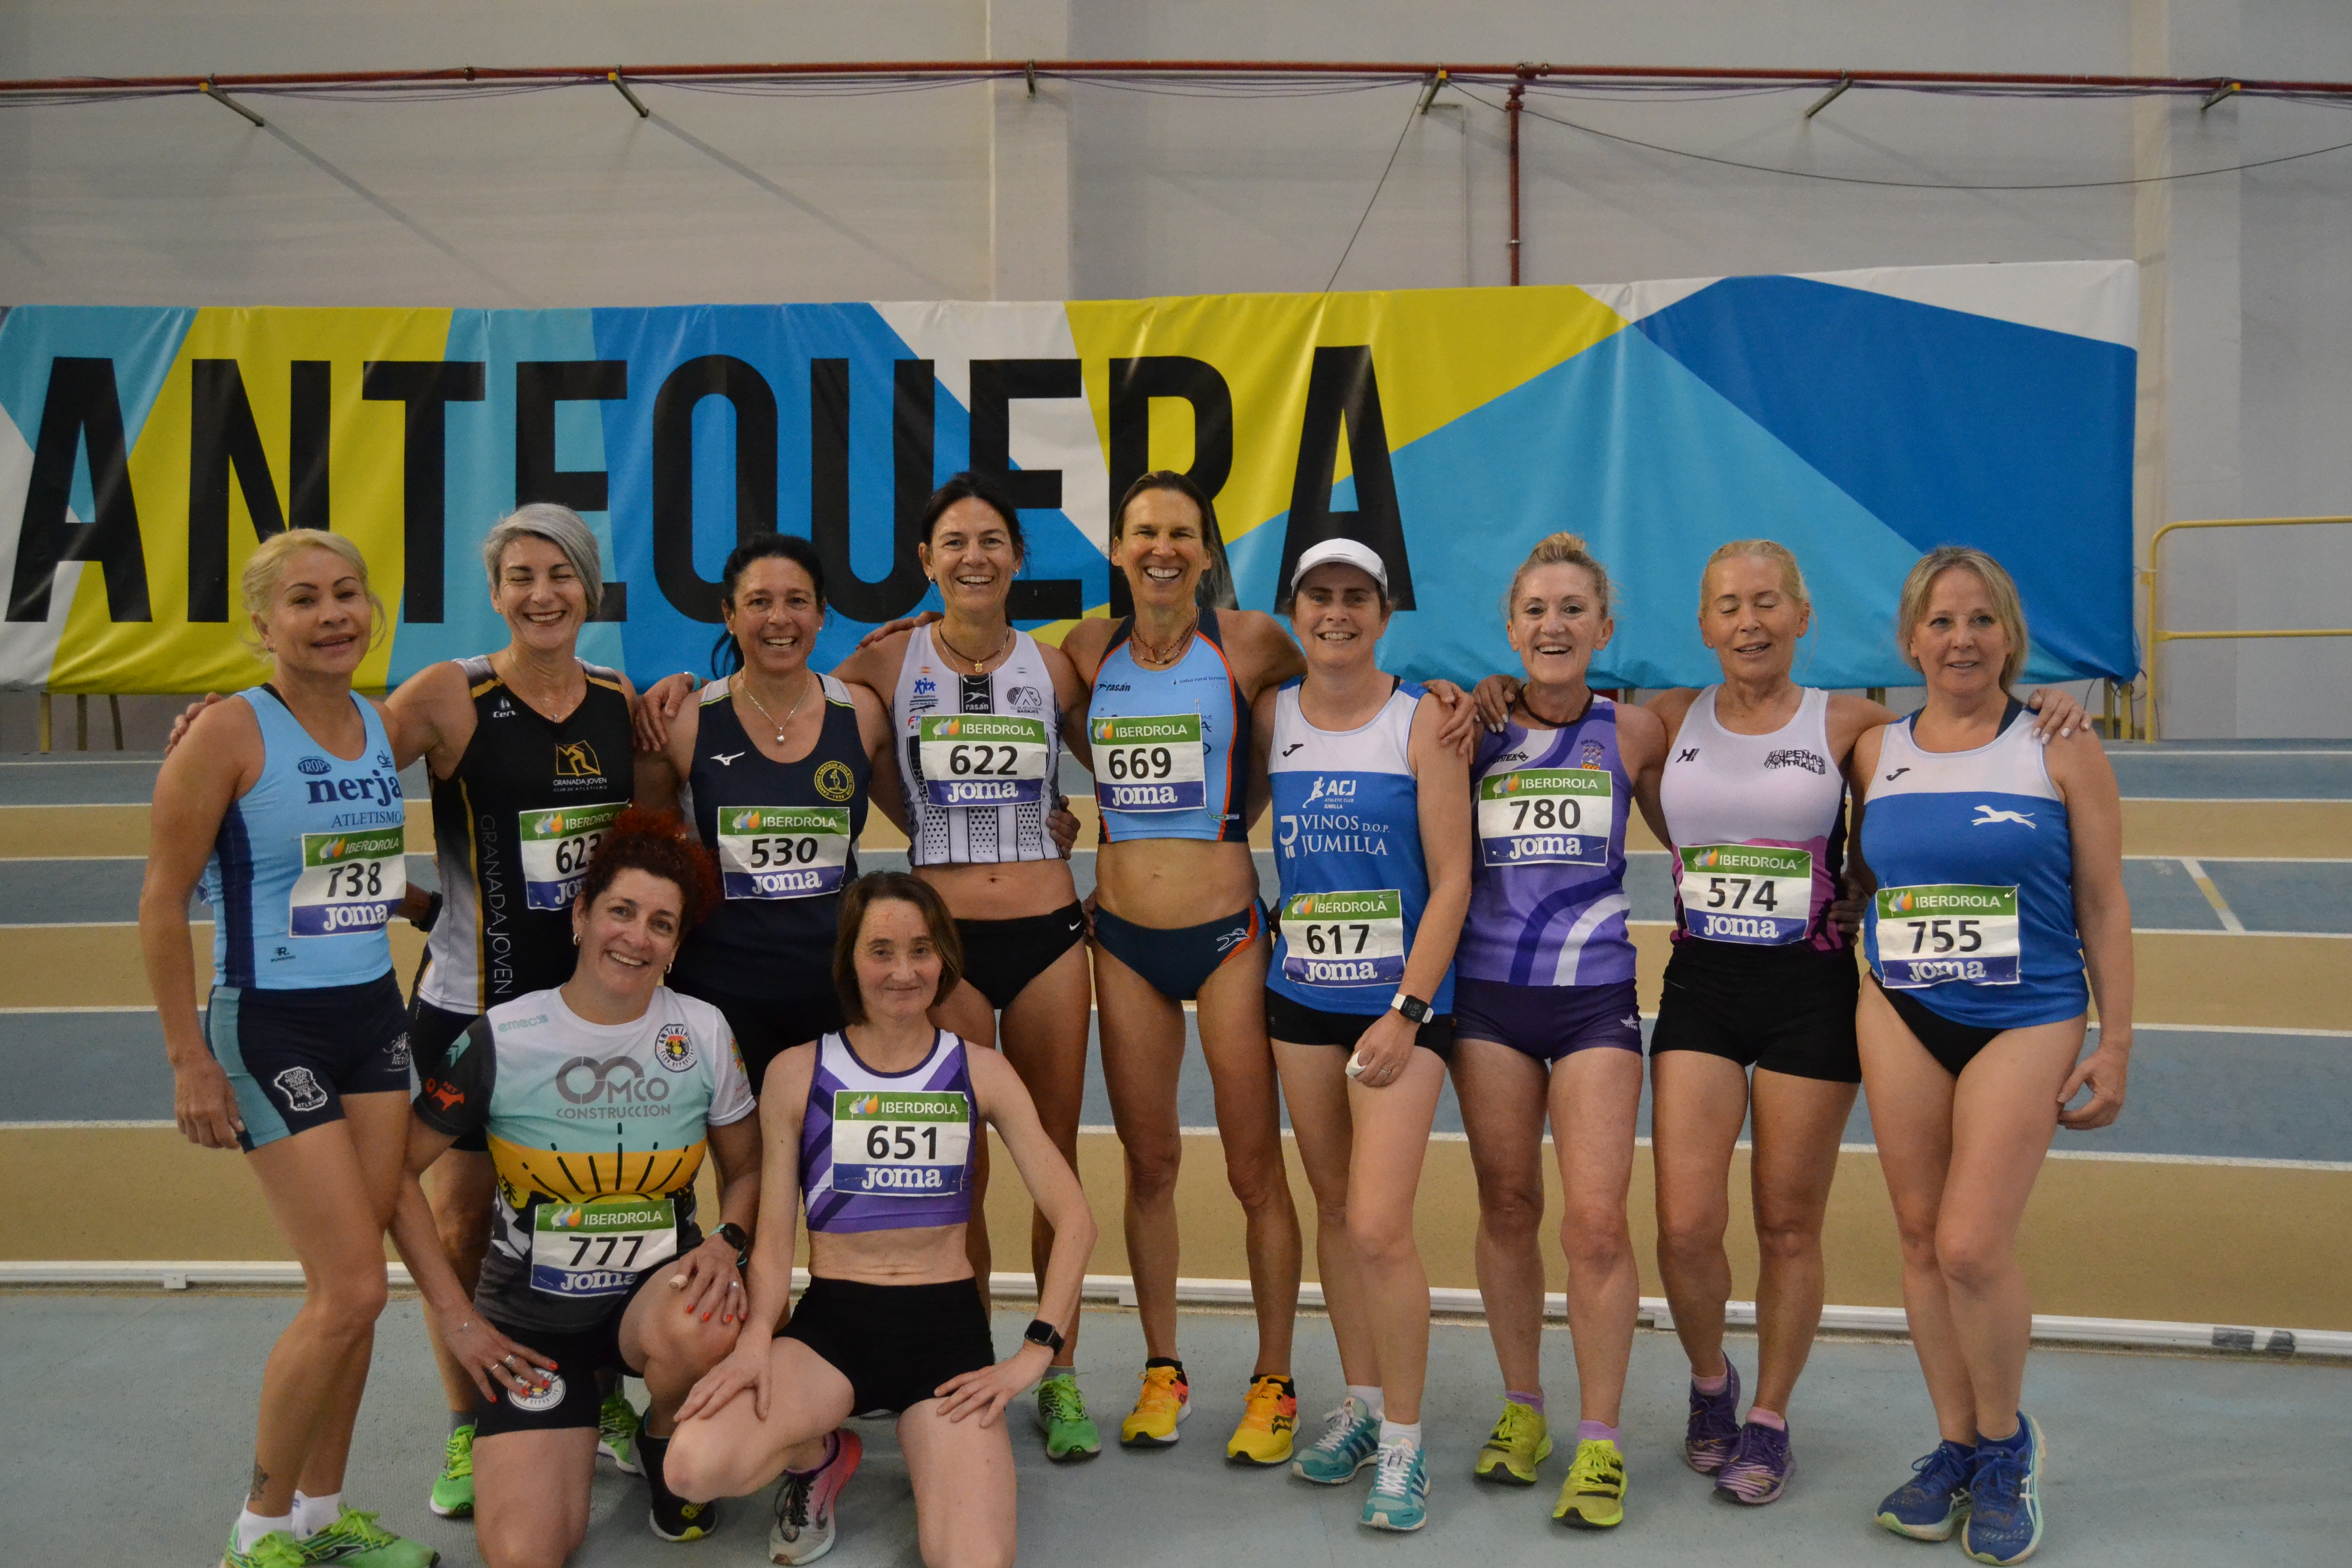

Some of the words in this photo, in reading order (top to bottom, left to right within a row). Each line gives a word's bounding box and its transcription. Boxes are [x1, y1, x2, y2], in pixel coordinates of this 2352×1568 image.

[1106, 682, 1131, 692] rasán
[965, 702, 989, 710] rasán
[962, 724, 1036, 737] IBERDROLA
[1116, 724, 1188, 738] IBERDROLA
[300, 760, 331, 772] TROPS
[949, 745, 1018, 776] 622
[1108, 747, 1172, 780] 669
[1785, 760, 1818, 773] TRAIL
[586, 777, 607, 786] JOVEN
[819, 763, 838, 775] AMATEUR
[838, 765, 853, 783] ATHLETIC
[306, 769, 403, 806] nerja
[947, 781, 1019, 803] Joma
[1522, 778, 1598, 789] IBERDROLA
[1112, 786, 1178, 806] Joma
[331, 811, 402, 828] ATLETISMO
[763, 817, 837, 828] IBERDROLA
[1300, 814, 1359, 830] VINOS
[1362, 823, 1390, 833] D.O.P.
[1509, 798, 1581, 830] 780
[345, 838, 399, 854] IBERDROLA
[750, 837, 818, 869] 530
[1301, 835, 1388, 857] JUMILLA
[1509, 836, 1582, 860] Joma
[481, 814, 508, 926] GRANADA
[1719, 854, 1797, 870] IBERDROLA
[327, 862, 382, 898] 738
[752, 871, 822, 895] Joma
[1706, 877, 1778, 912] 574
[1915, 895, 2001, 909] IBERDROLA
[323, 904, 388, 930] Joma
[1314, 901, 1387, 914] IBERDROLA
[1703, 915, 1779, 939] Joma
[1906, 919, 1982, 954] 755
[1306, 924, 1370, 954] 617
[487, 927, 512, 994] JOVEN
[1305, 961, 1378, 982] Joma
[1908, 960, 1987, 982] Joma
[443, 1081, 457, 1093] PET
[297, 1094, 325, 1108] ATLETISMO
[881, 1101, 959, 1115] IBERDROLA
[556, 1104, 671, 1119] CONSTRUCCION
[866, 1124, 937, 1160] 651
[861, 1167, 943, 1190] Joma
[584, 1210, 663, 1226] IBERDROLA
[569, 1235, 644, 1267] 777
[529, 1389, 559, 1404] DEPORTIVO
